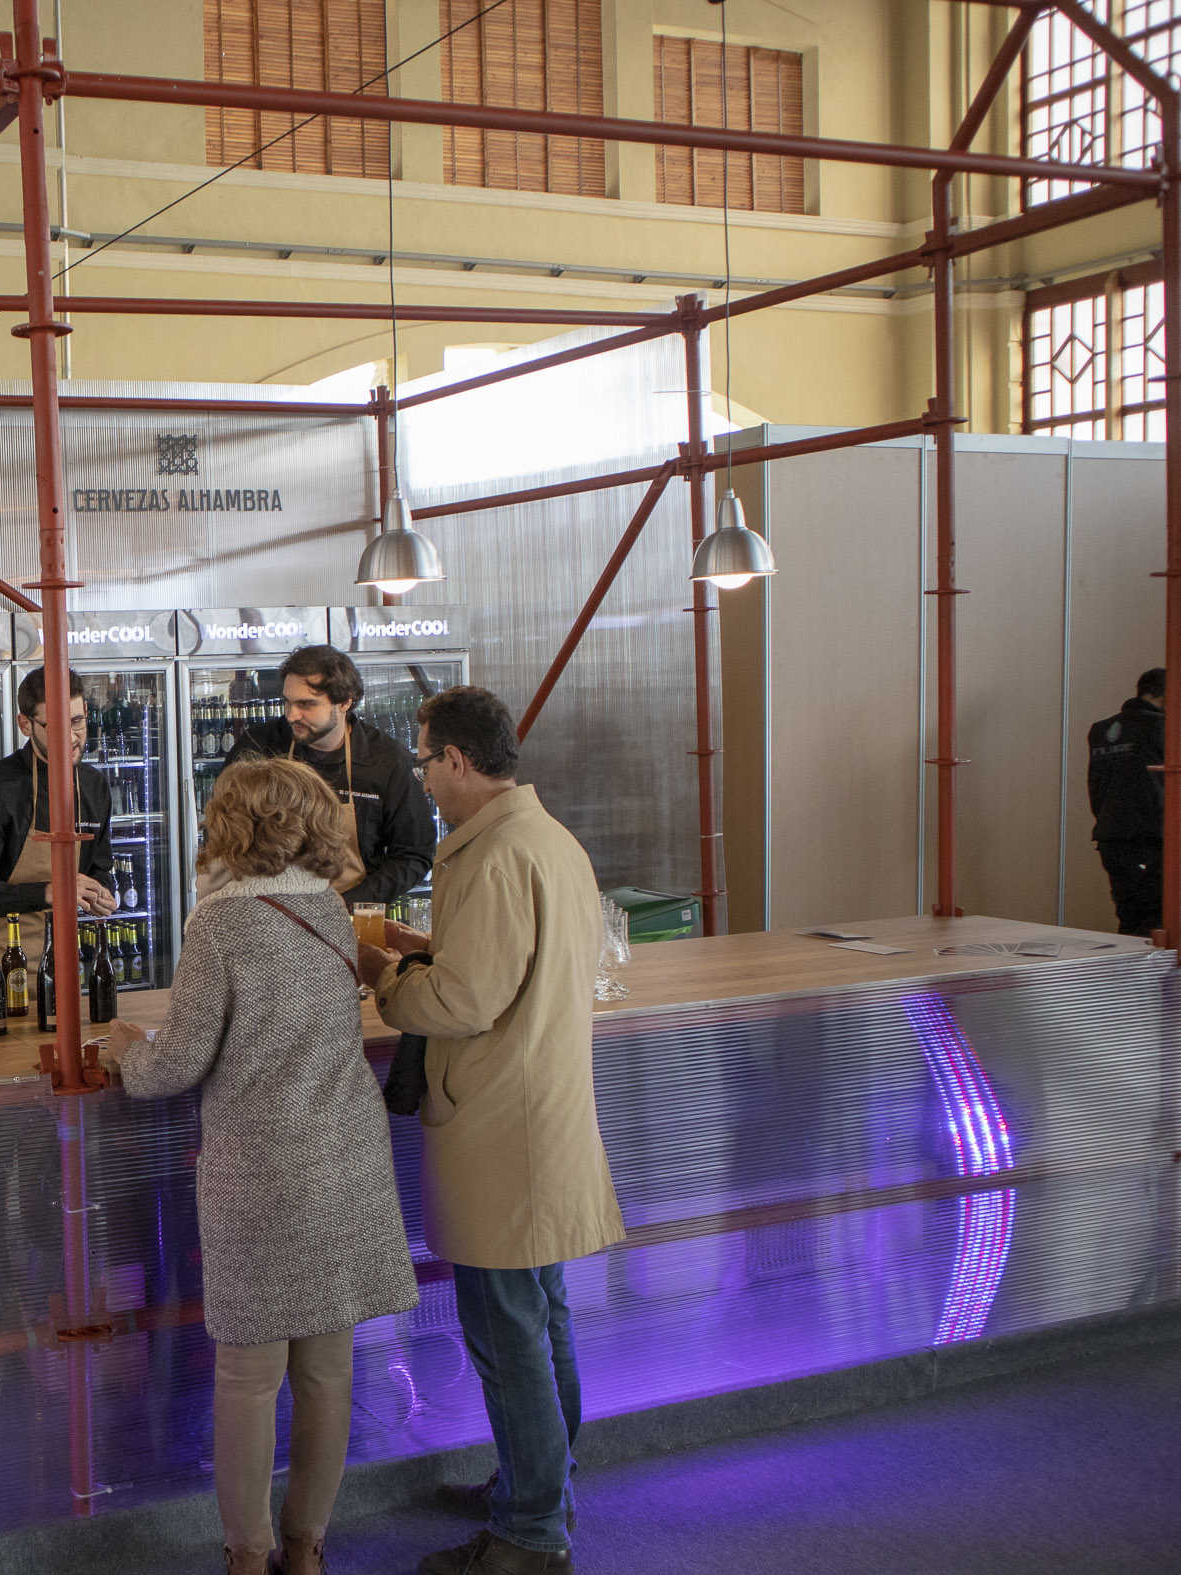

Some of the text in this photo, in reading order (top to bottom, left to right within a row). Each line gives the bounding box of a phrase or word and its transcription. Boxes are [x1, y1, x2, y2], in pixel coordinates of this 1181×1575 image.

[73, 488, 283, 512] CERVEZAS ALHAMBRA
[352, 619, 451, 637] WonderCOOL
